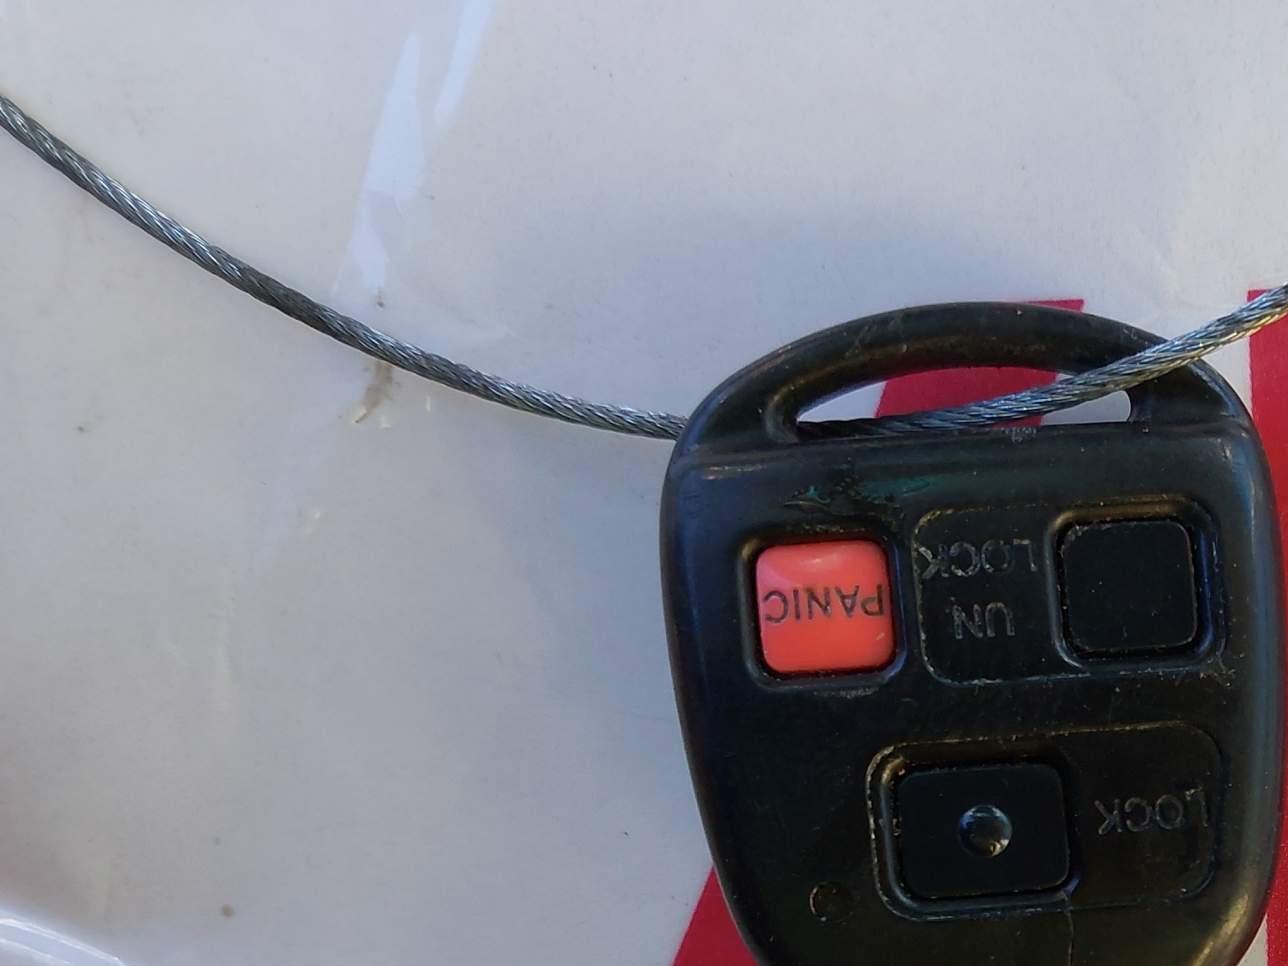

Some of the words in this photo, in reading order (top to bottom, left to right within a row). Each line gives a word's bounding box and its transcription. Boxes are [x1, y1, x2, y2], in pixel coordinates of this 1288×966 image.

[919, 539, 1038, 578] LOCK
[763, 583, 887, 623] PANIC
[951, 600, 1016, 638] UN
[1094, 787, 1208, 834] LOCK
